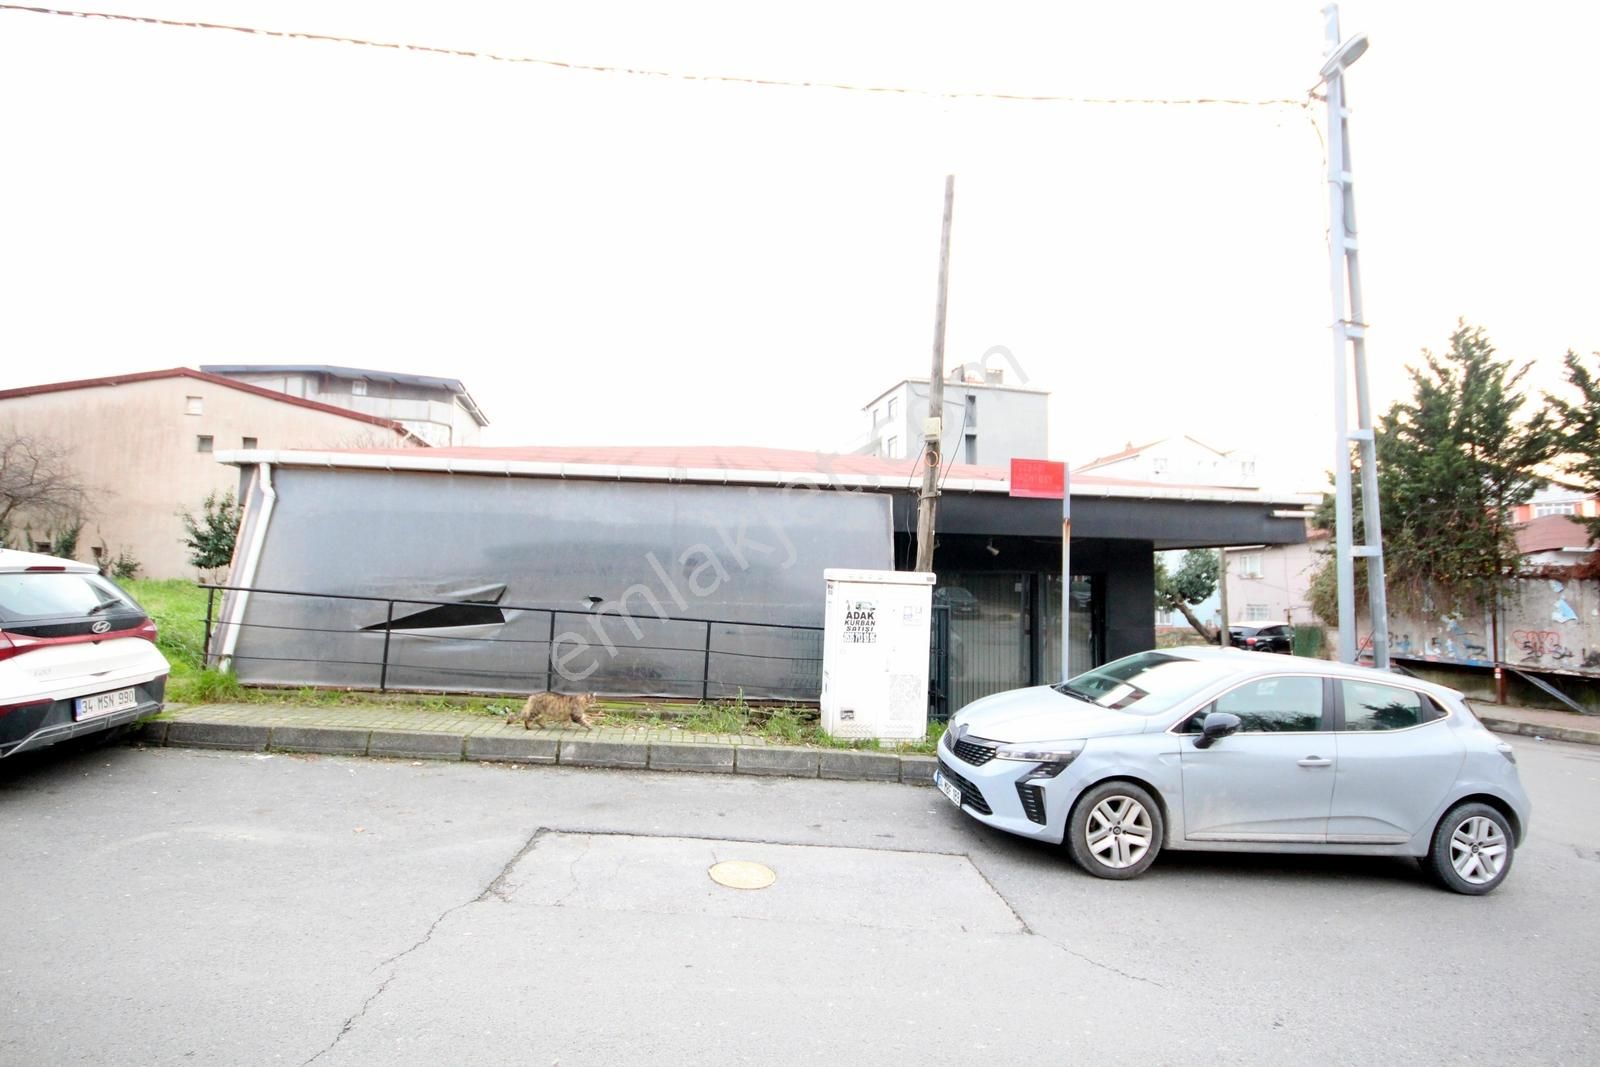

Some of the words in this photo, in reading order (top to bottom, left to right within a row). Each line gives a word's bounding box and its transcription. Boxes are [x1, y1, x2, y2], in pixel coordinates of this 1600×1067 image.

[846, 611, 874, 620] ADAK
[82, 700, 93, 714] 34
[98, 694, 114, 710] MSN
[118, 690, 134, 704] 990
